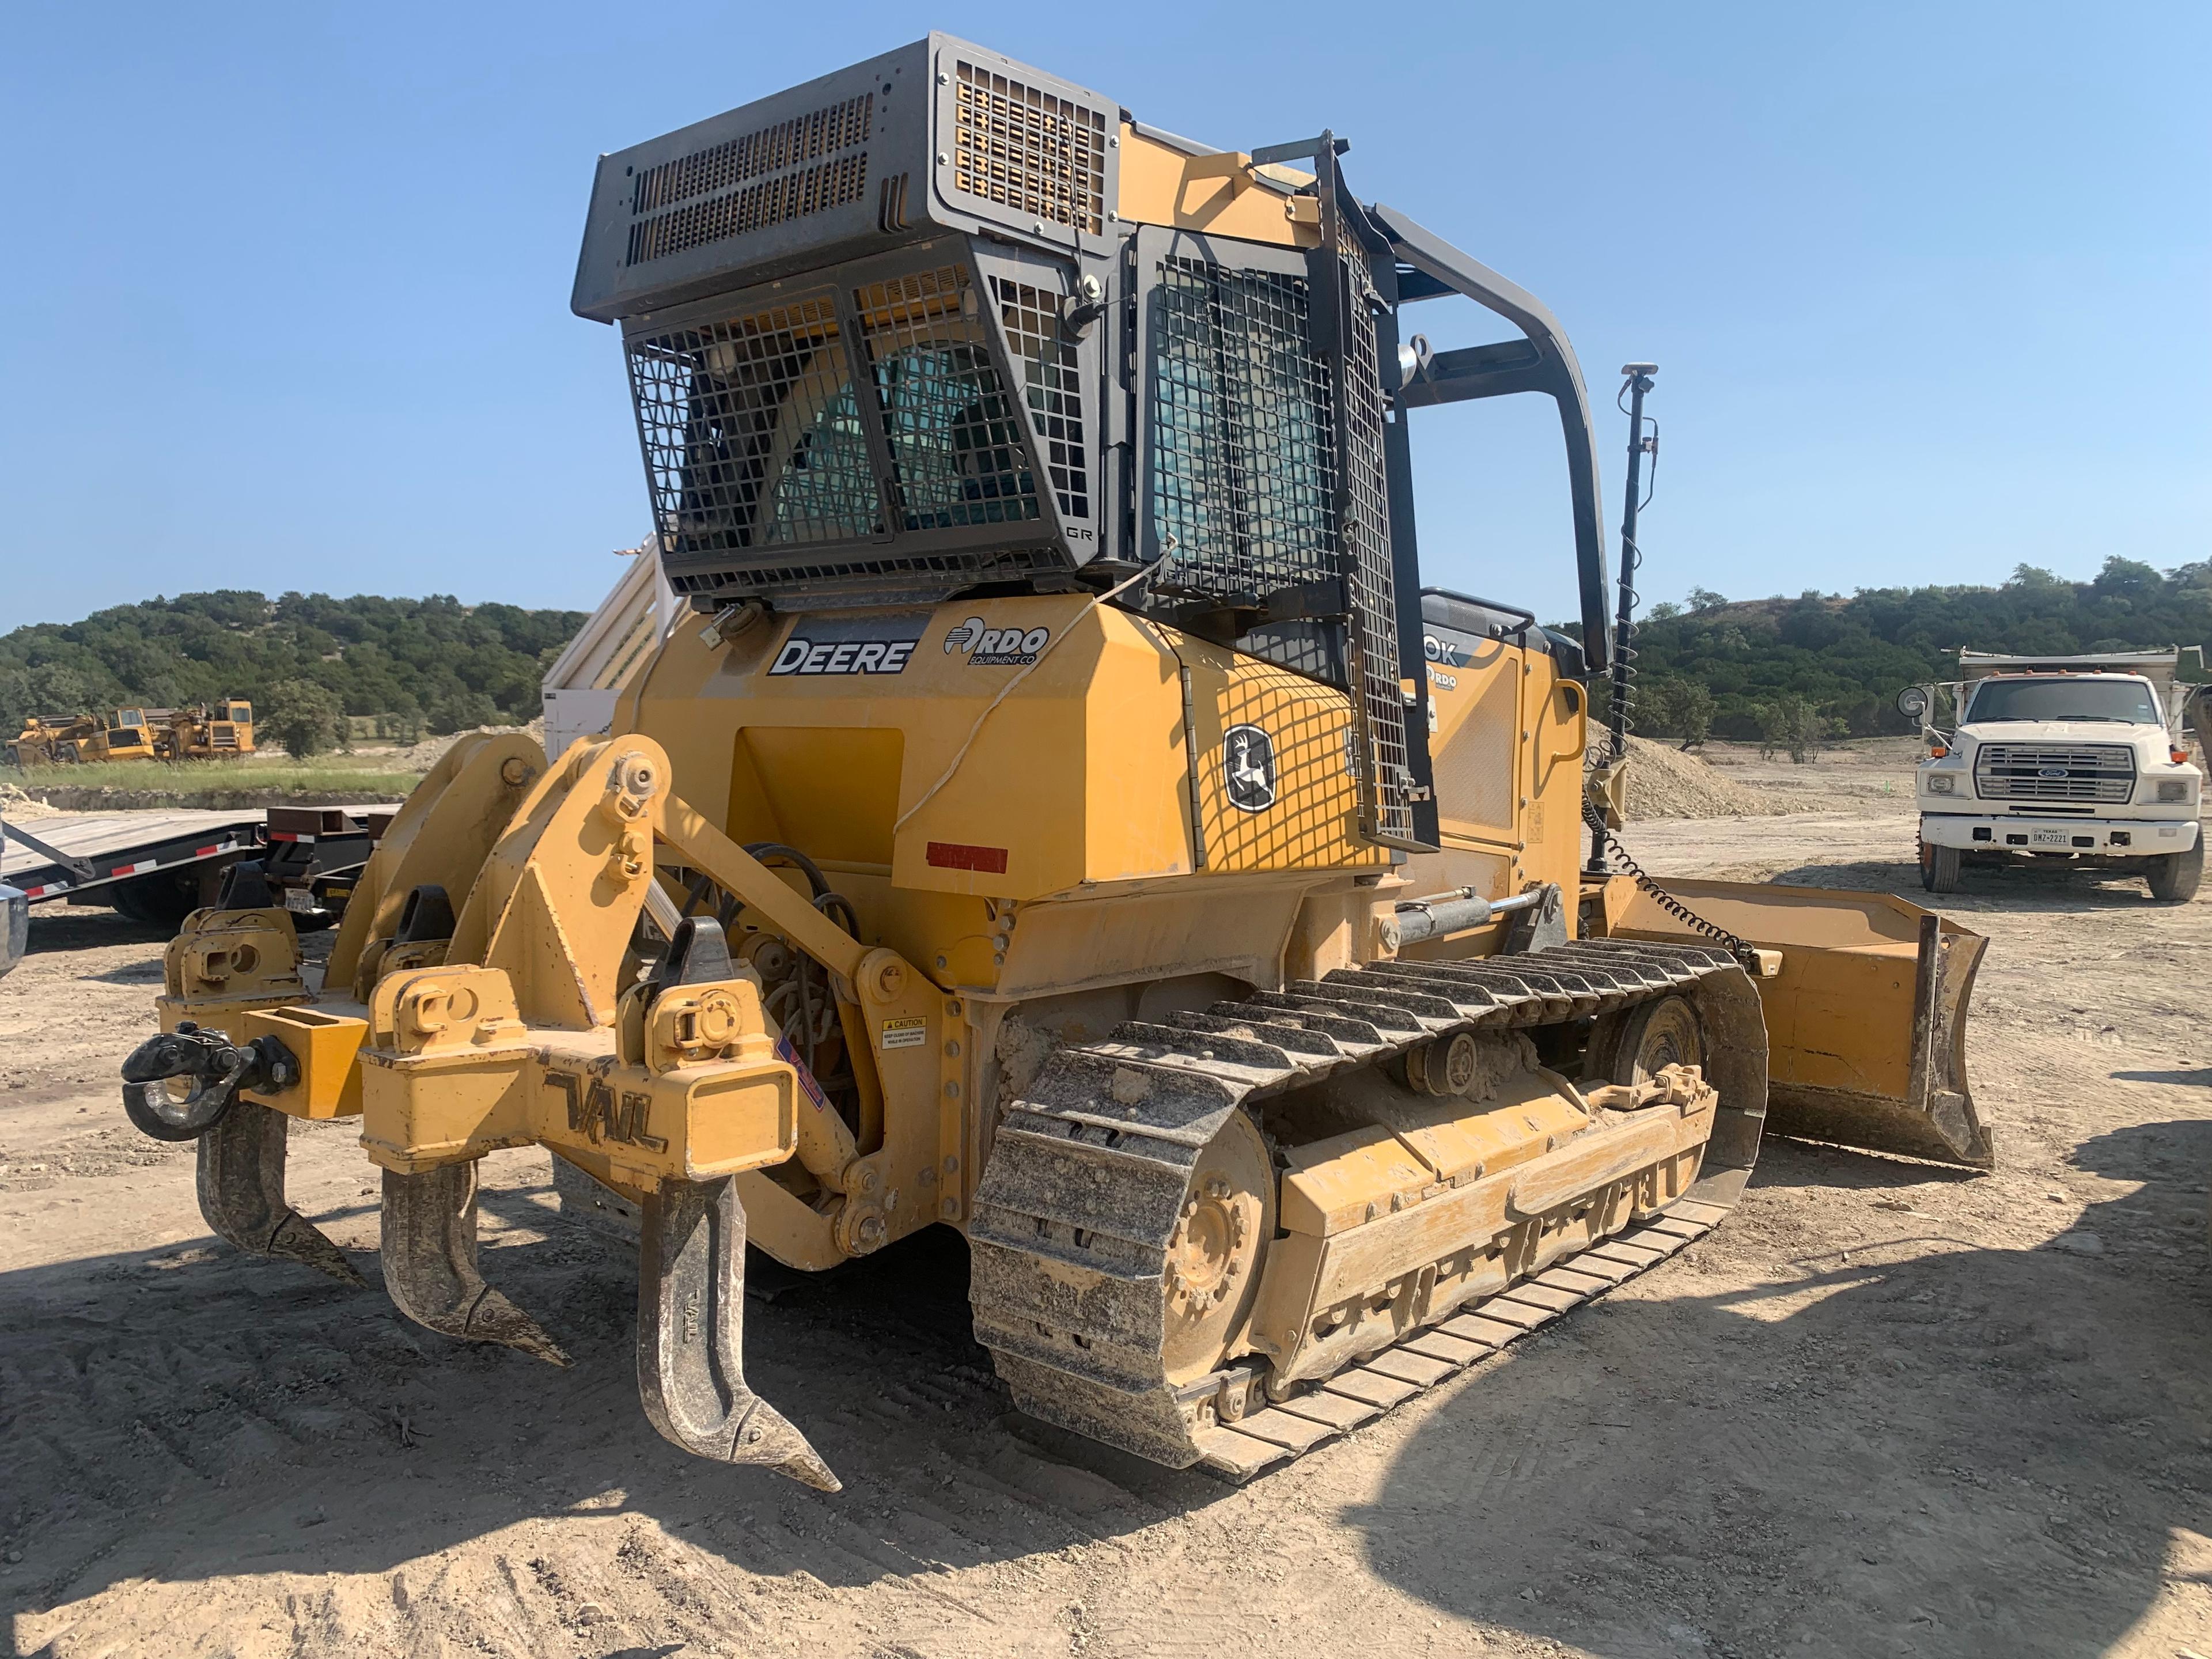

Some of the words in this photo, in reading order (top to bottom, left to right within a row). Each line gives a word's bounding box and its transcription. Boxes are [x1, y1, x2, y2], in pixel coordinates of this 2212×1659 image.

[1066, 527, 1093, 541] GR
[766, 637, 921, 676] DEERE
[969, 656, 1017, 665] EQUIPMENT
[1020, 656, 1035, 665] CO
[895, 1018, 923, 1028] CAUTION
